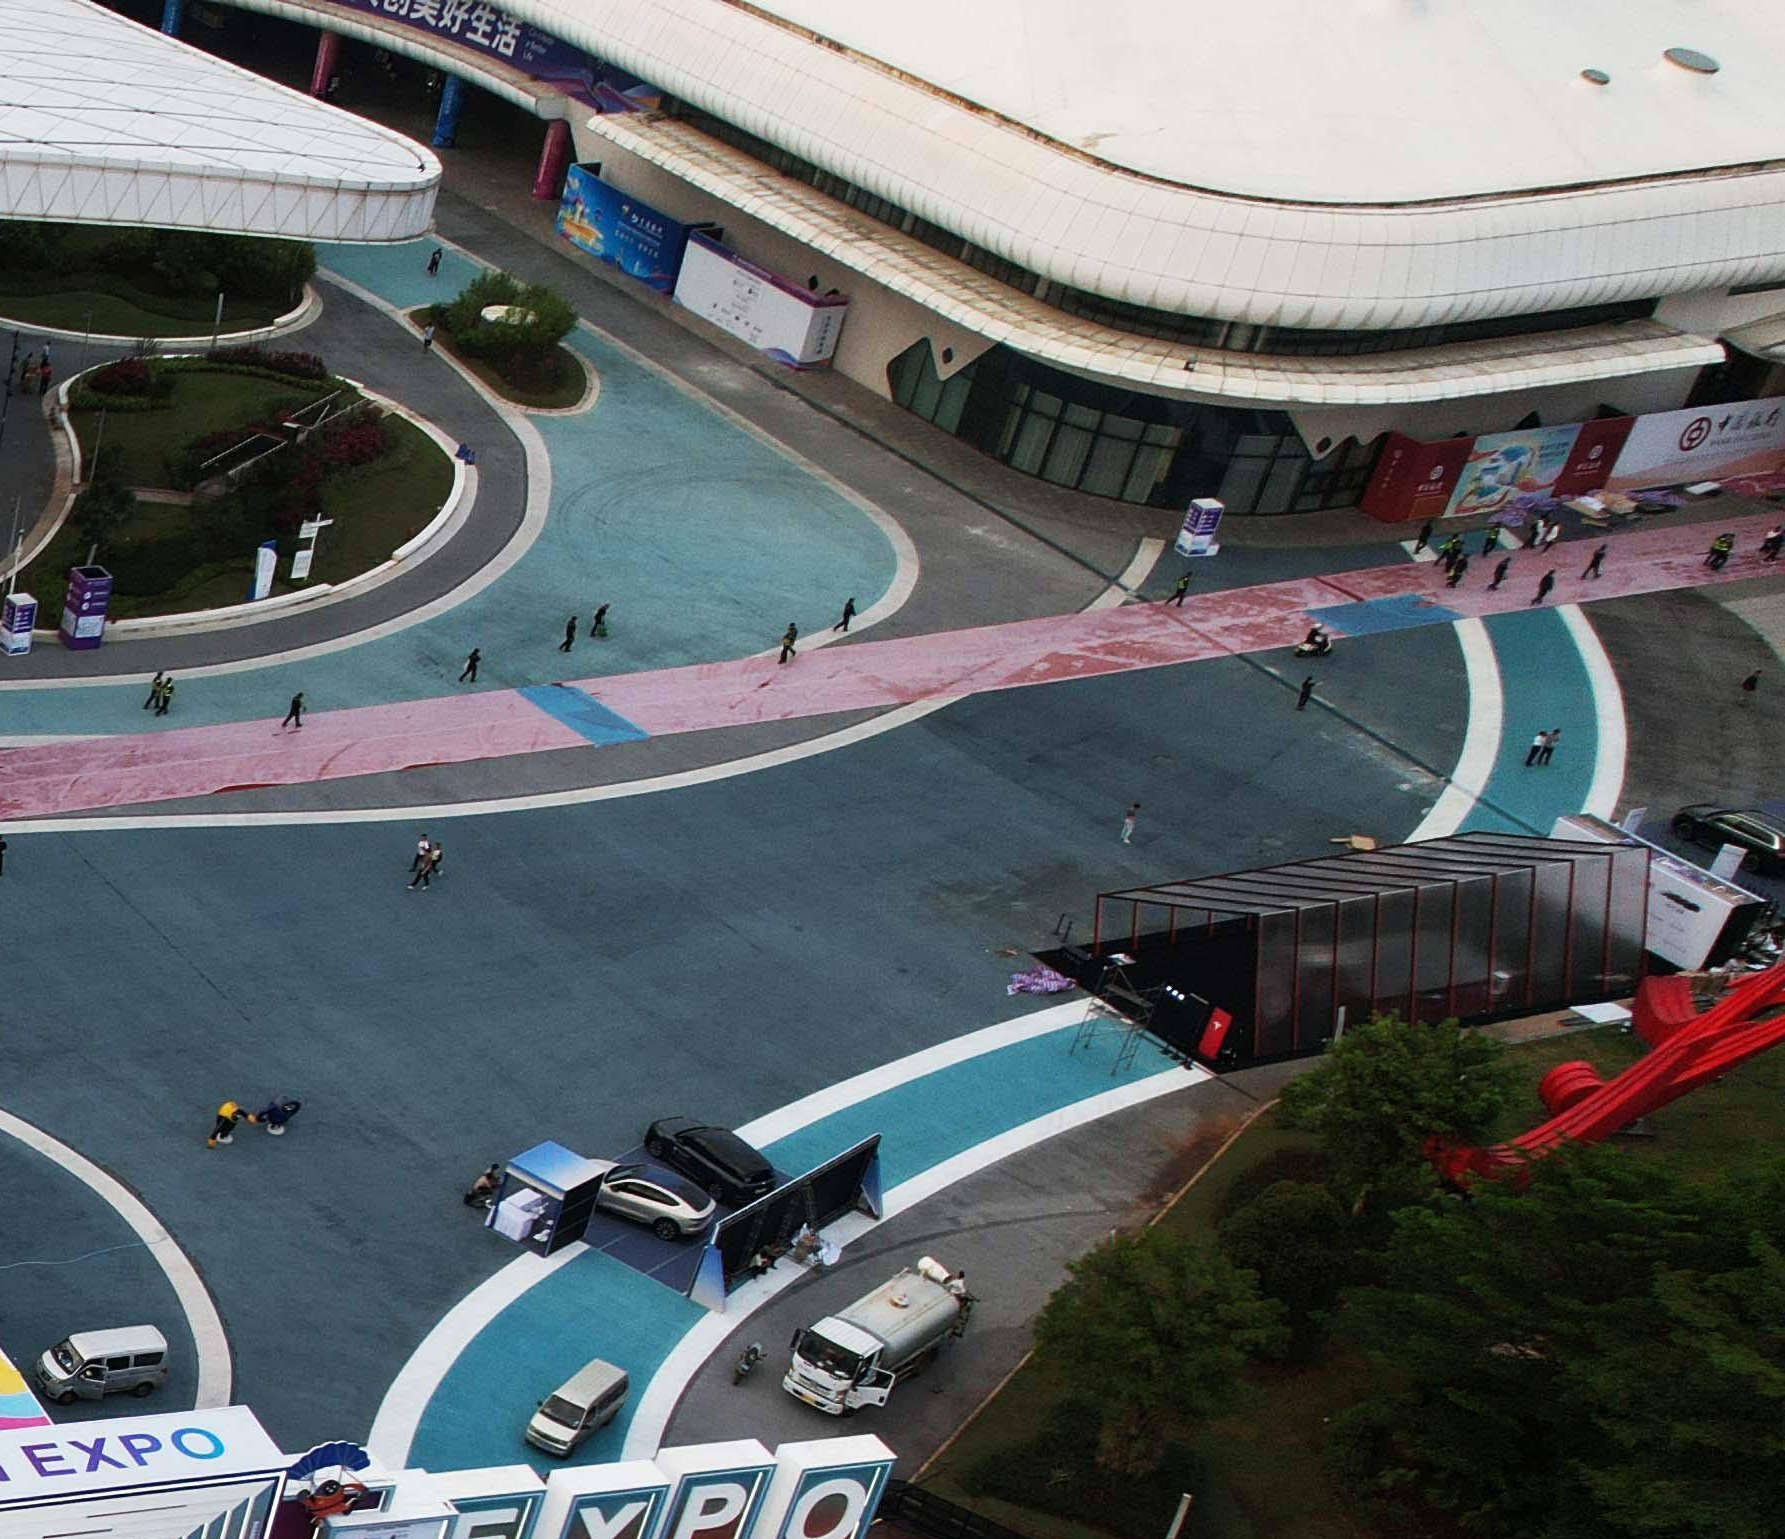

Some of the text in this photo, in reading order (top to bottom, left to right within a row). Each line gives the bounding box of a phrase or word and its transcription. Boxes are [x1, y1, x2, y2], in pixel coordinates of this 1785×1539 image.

[348, 0, 520, 57] 创美好生活
[23, 1427, 226, 1481] EXPO
